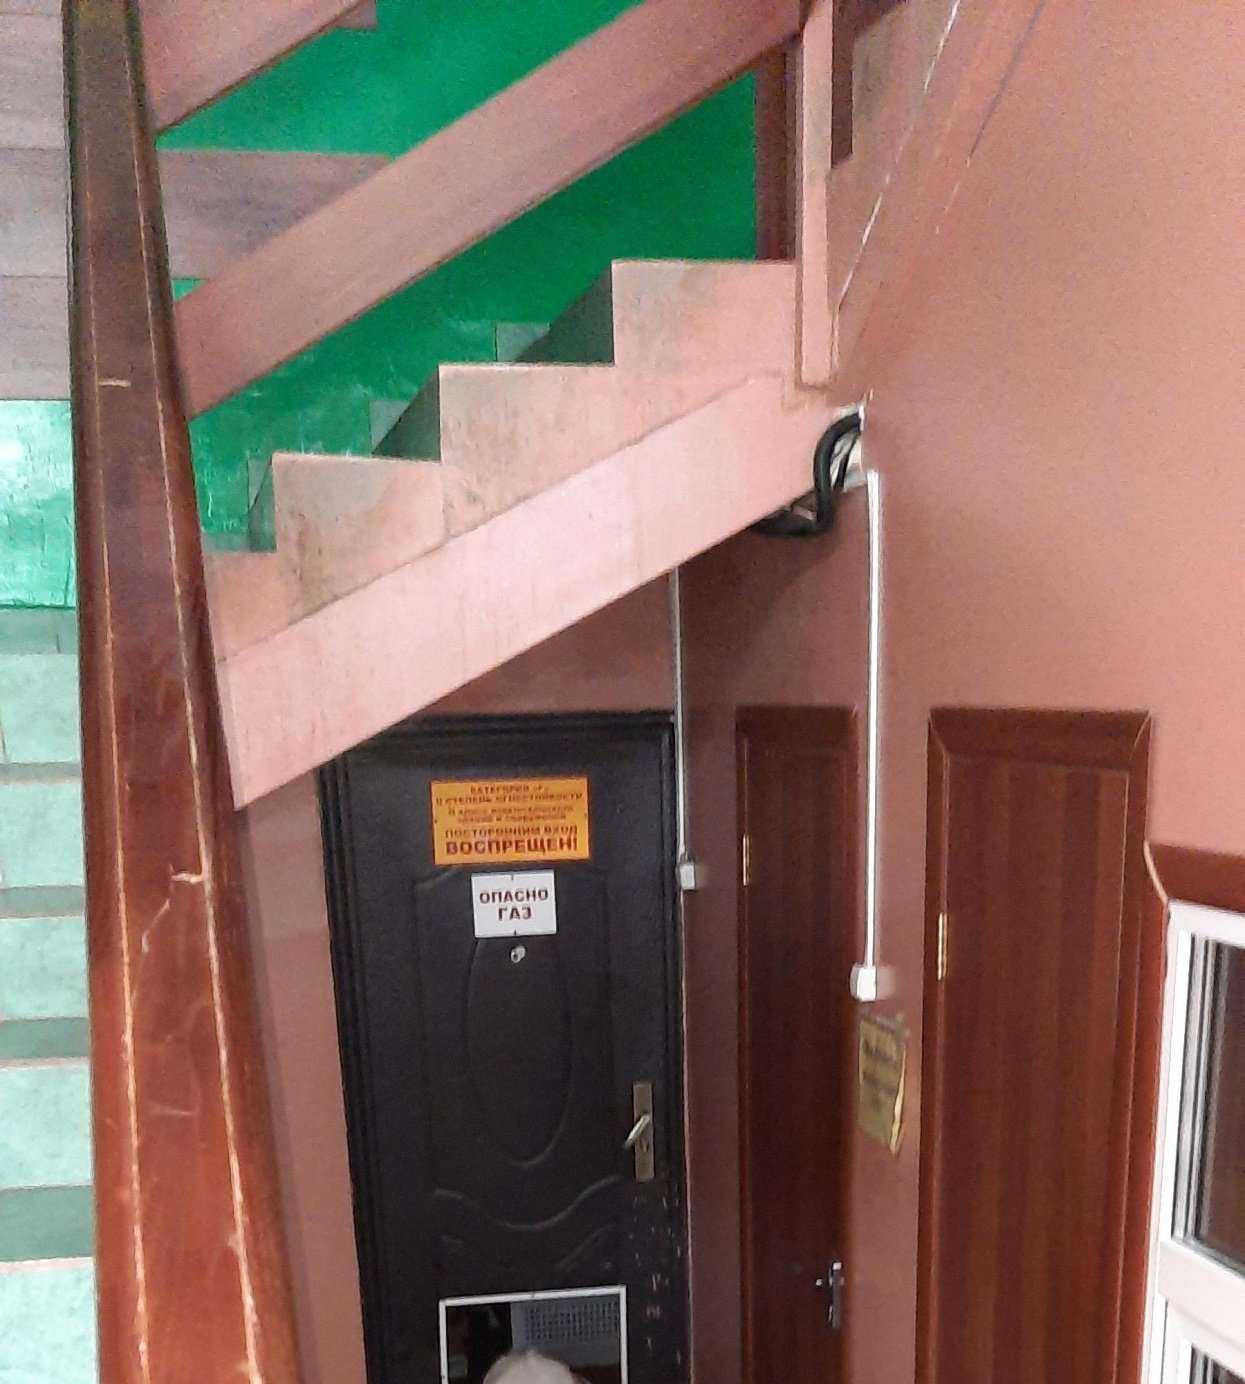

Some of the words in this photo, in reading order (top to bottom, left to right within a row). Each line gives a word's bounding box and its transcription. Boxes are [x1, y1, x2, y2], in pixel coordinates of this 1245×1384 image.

[445, 825, 540, 838] ПОСТОРОННИМ
[544, 824, 578, 835] ВХОД
[446, 837, 578, 855] ВОСПРЕЩЕН!
[480, 889, 548, 904] ОПАСНО
[499, 906, 532, 921] ГАЗ
